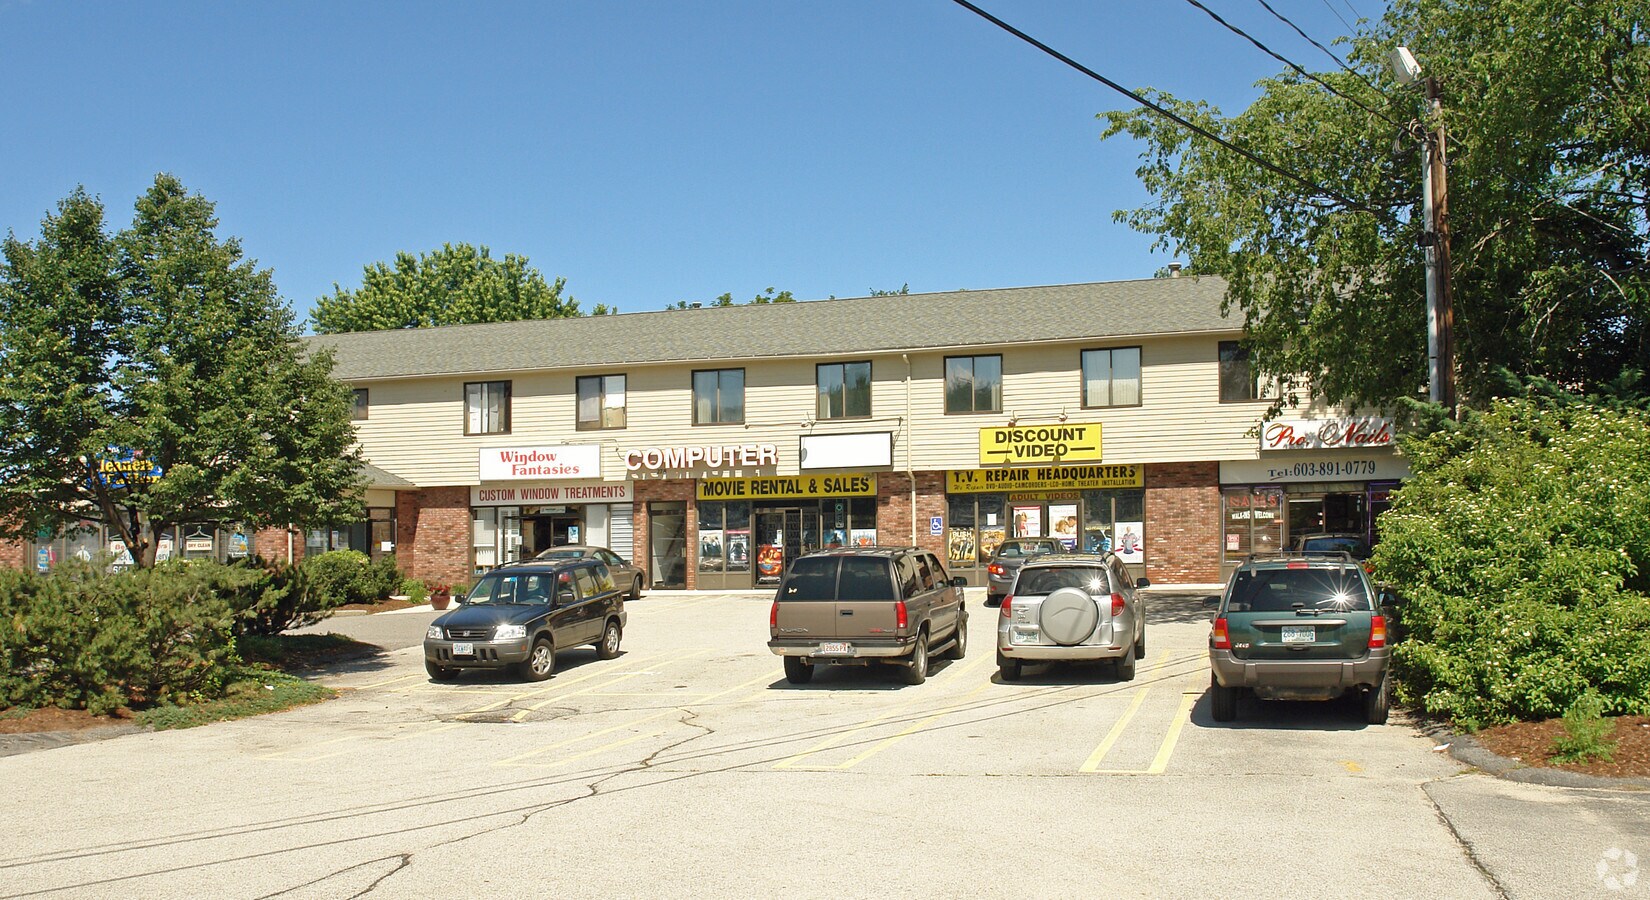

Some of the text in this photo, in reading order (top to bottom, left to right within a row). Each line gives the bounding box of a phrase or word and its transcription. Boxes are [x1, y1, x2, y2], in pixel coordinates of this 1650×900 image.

[995, 428, 1086, 443] DISCOUNT
[1317, 420, 1390, 446] Nails
[500, 450, 557, 466] Window
[624, 443, 779, 470] COMPUTER
[1014, 443, 1068, 457] VIDEO
[511, 463, 580, 476] Fantasies
[954, 466, 1136, 483] T.V. REPAIR HEADQUARTERS
[479, 486, 626, 502] CUSTOM WINDOW TREATMENTS
[703, 477, 870, 496] MOVIE RENTAL & SALES
[1011, 492, 1079, 501] ADULT VIDEOS
